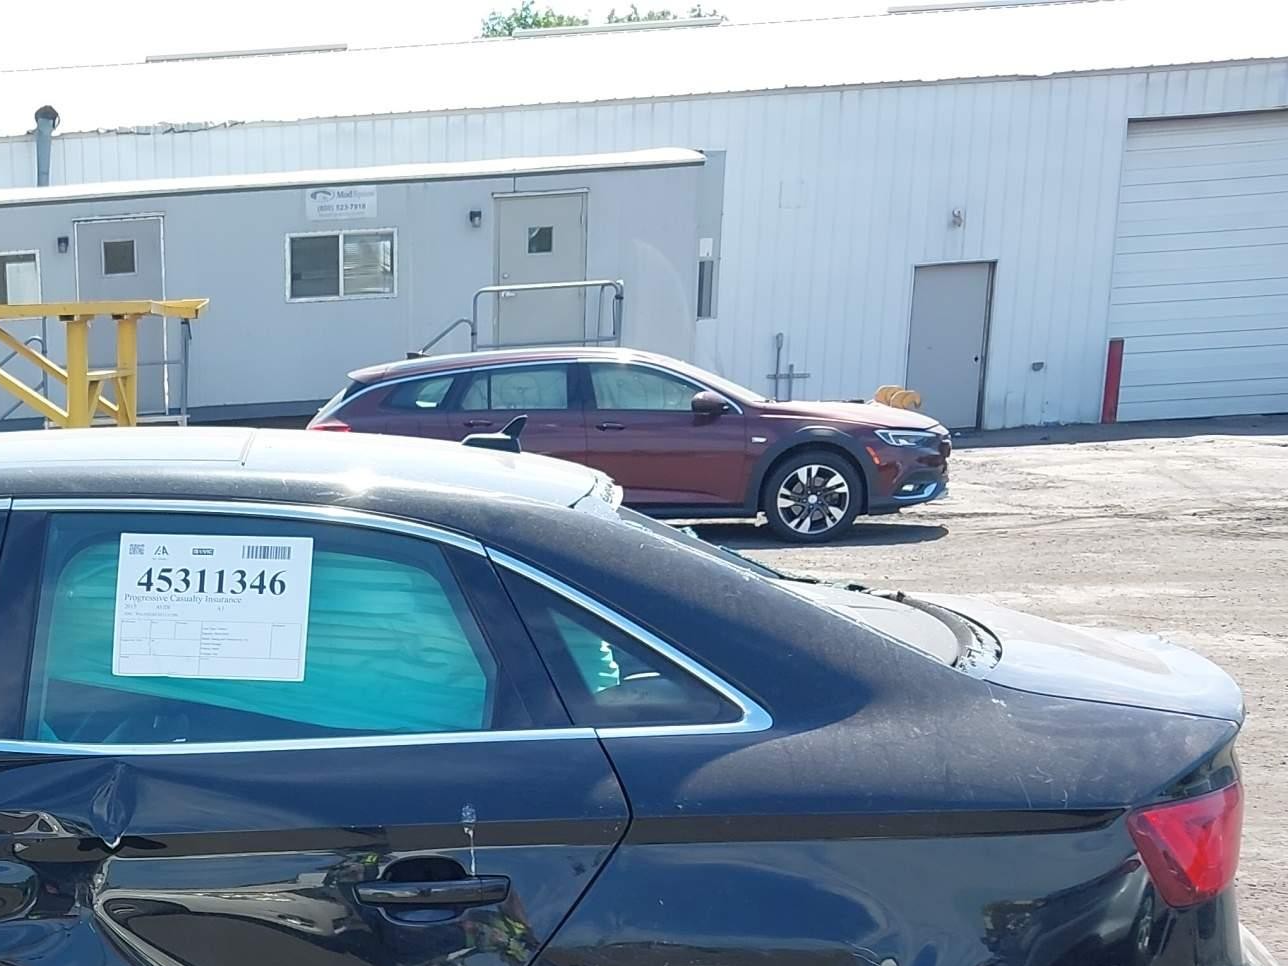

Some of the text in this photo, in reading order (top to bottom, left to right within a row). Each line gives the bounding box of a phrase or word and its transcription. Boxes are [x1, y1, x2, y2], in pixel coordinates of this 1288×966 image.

[137, 567, 289, 596] 45311346
[124, 593, 242, 604] Progressive Casualty Insurance
